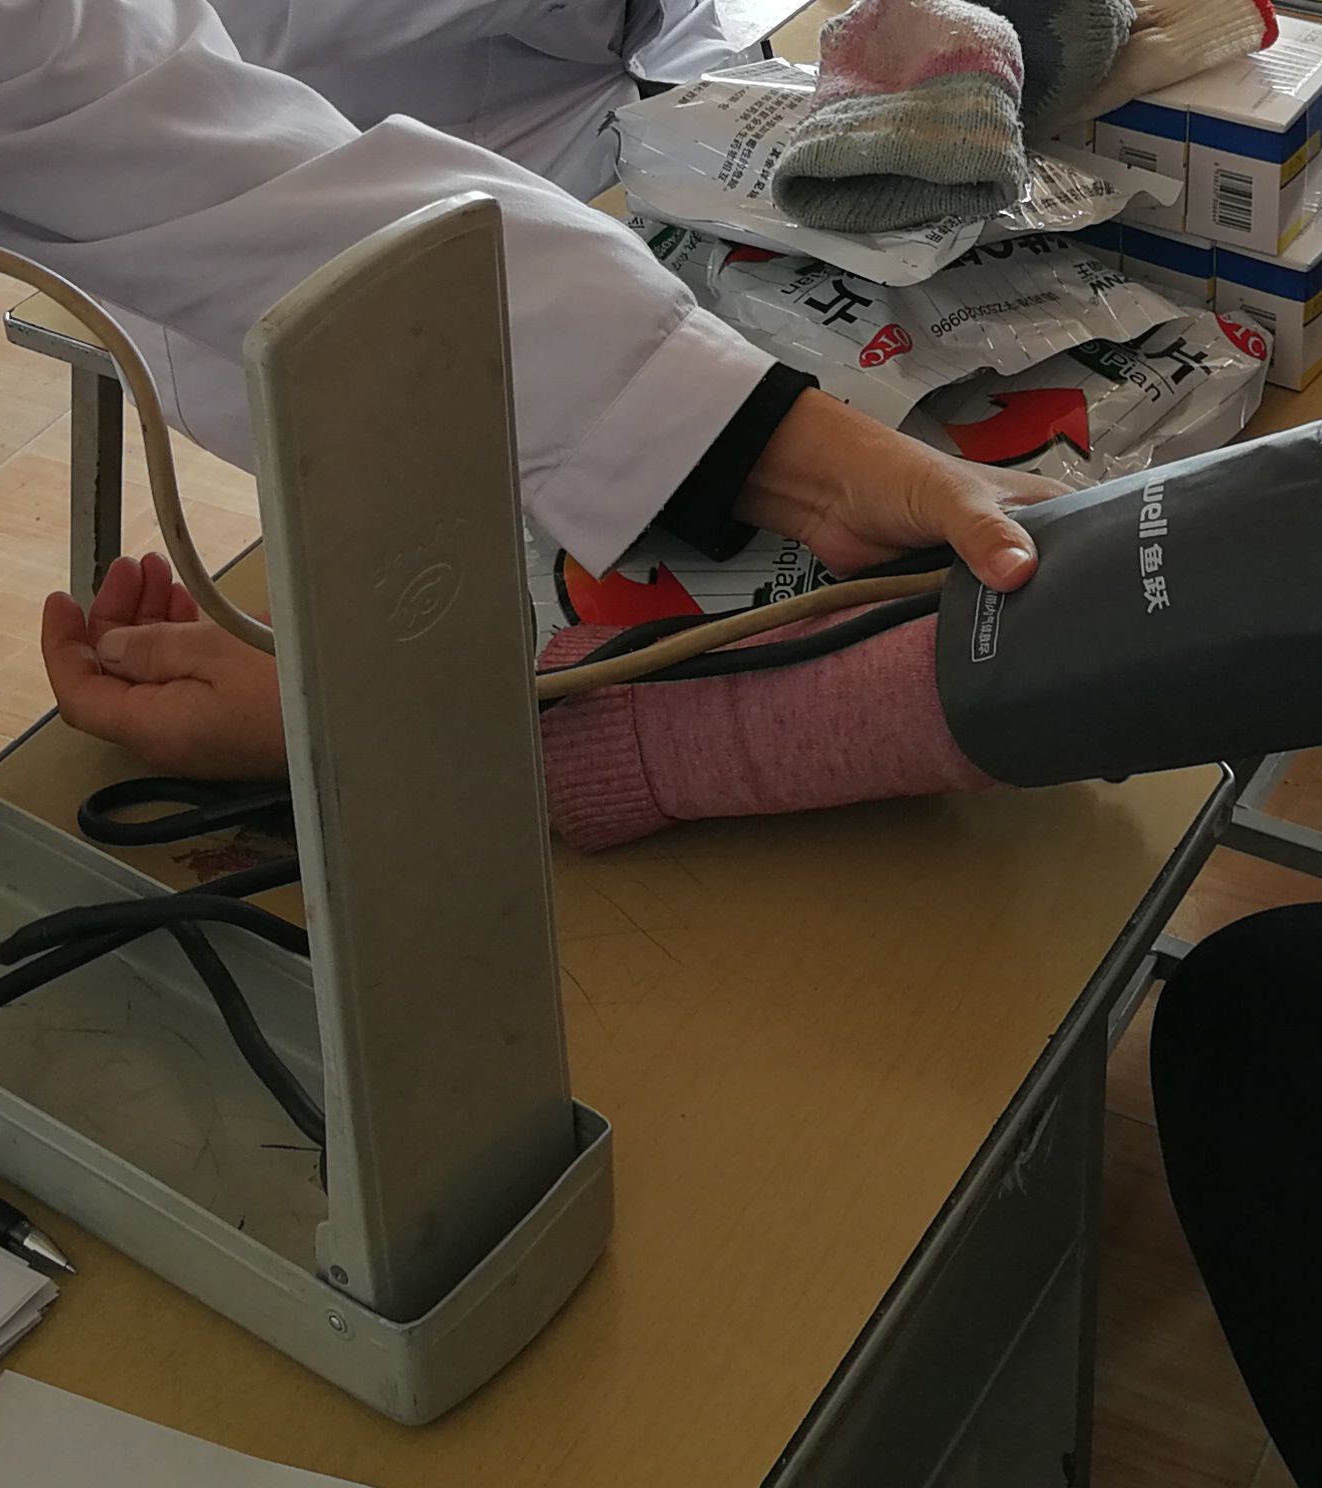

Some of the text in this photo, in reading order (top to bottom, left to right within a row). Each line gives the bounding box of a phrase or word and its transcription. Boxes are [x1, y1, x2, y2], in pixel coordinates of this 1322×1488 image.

[858, 326, 910, 368] OTC
[1101, 349, 1162, 403] Pian
[770, 536, 800, 603] nqiao
[1138, 476, 1172, 614] well 鱼跃
